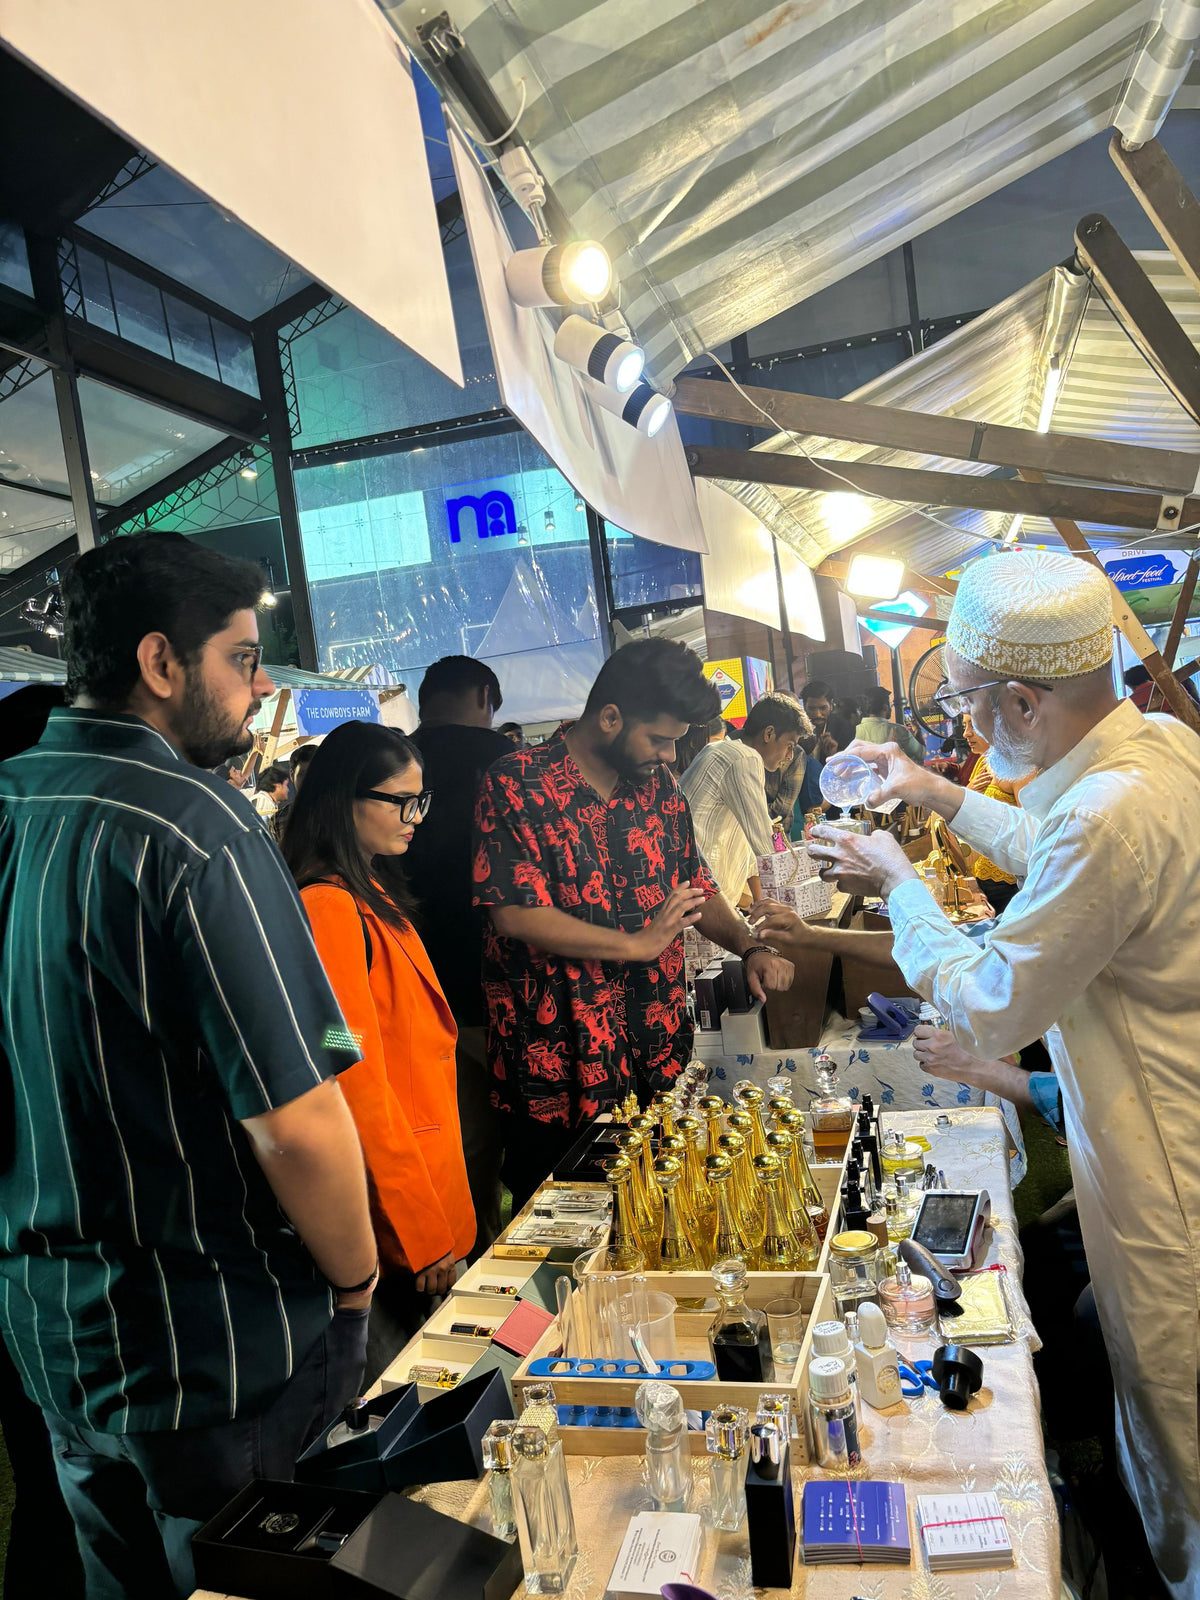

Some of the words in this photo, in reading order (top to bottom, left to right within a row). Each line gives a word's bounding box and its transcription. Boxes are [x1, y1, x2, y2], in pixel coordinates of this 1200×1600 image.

[305, 707, 320, 719] THE
[320, 706, 352, 719] COWBOYS
[352, 706, 371, 718] FARM
